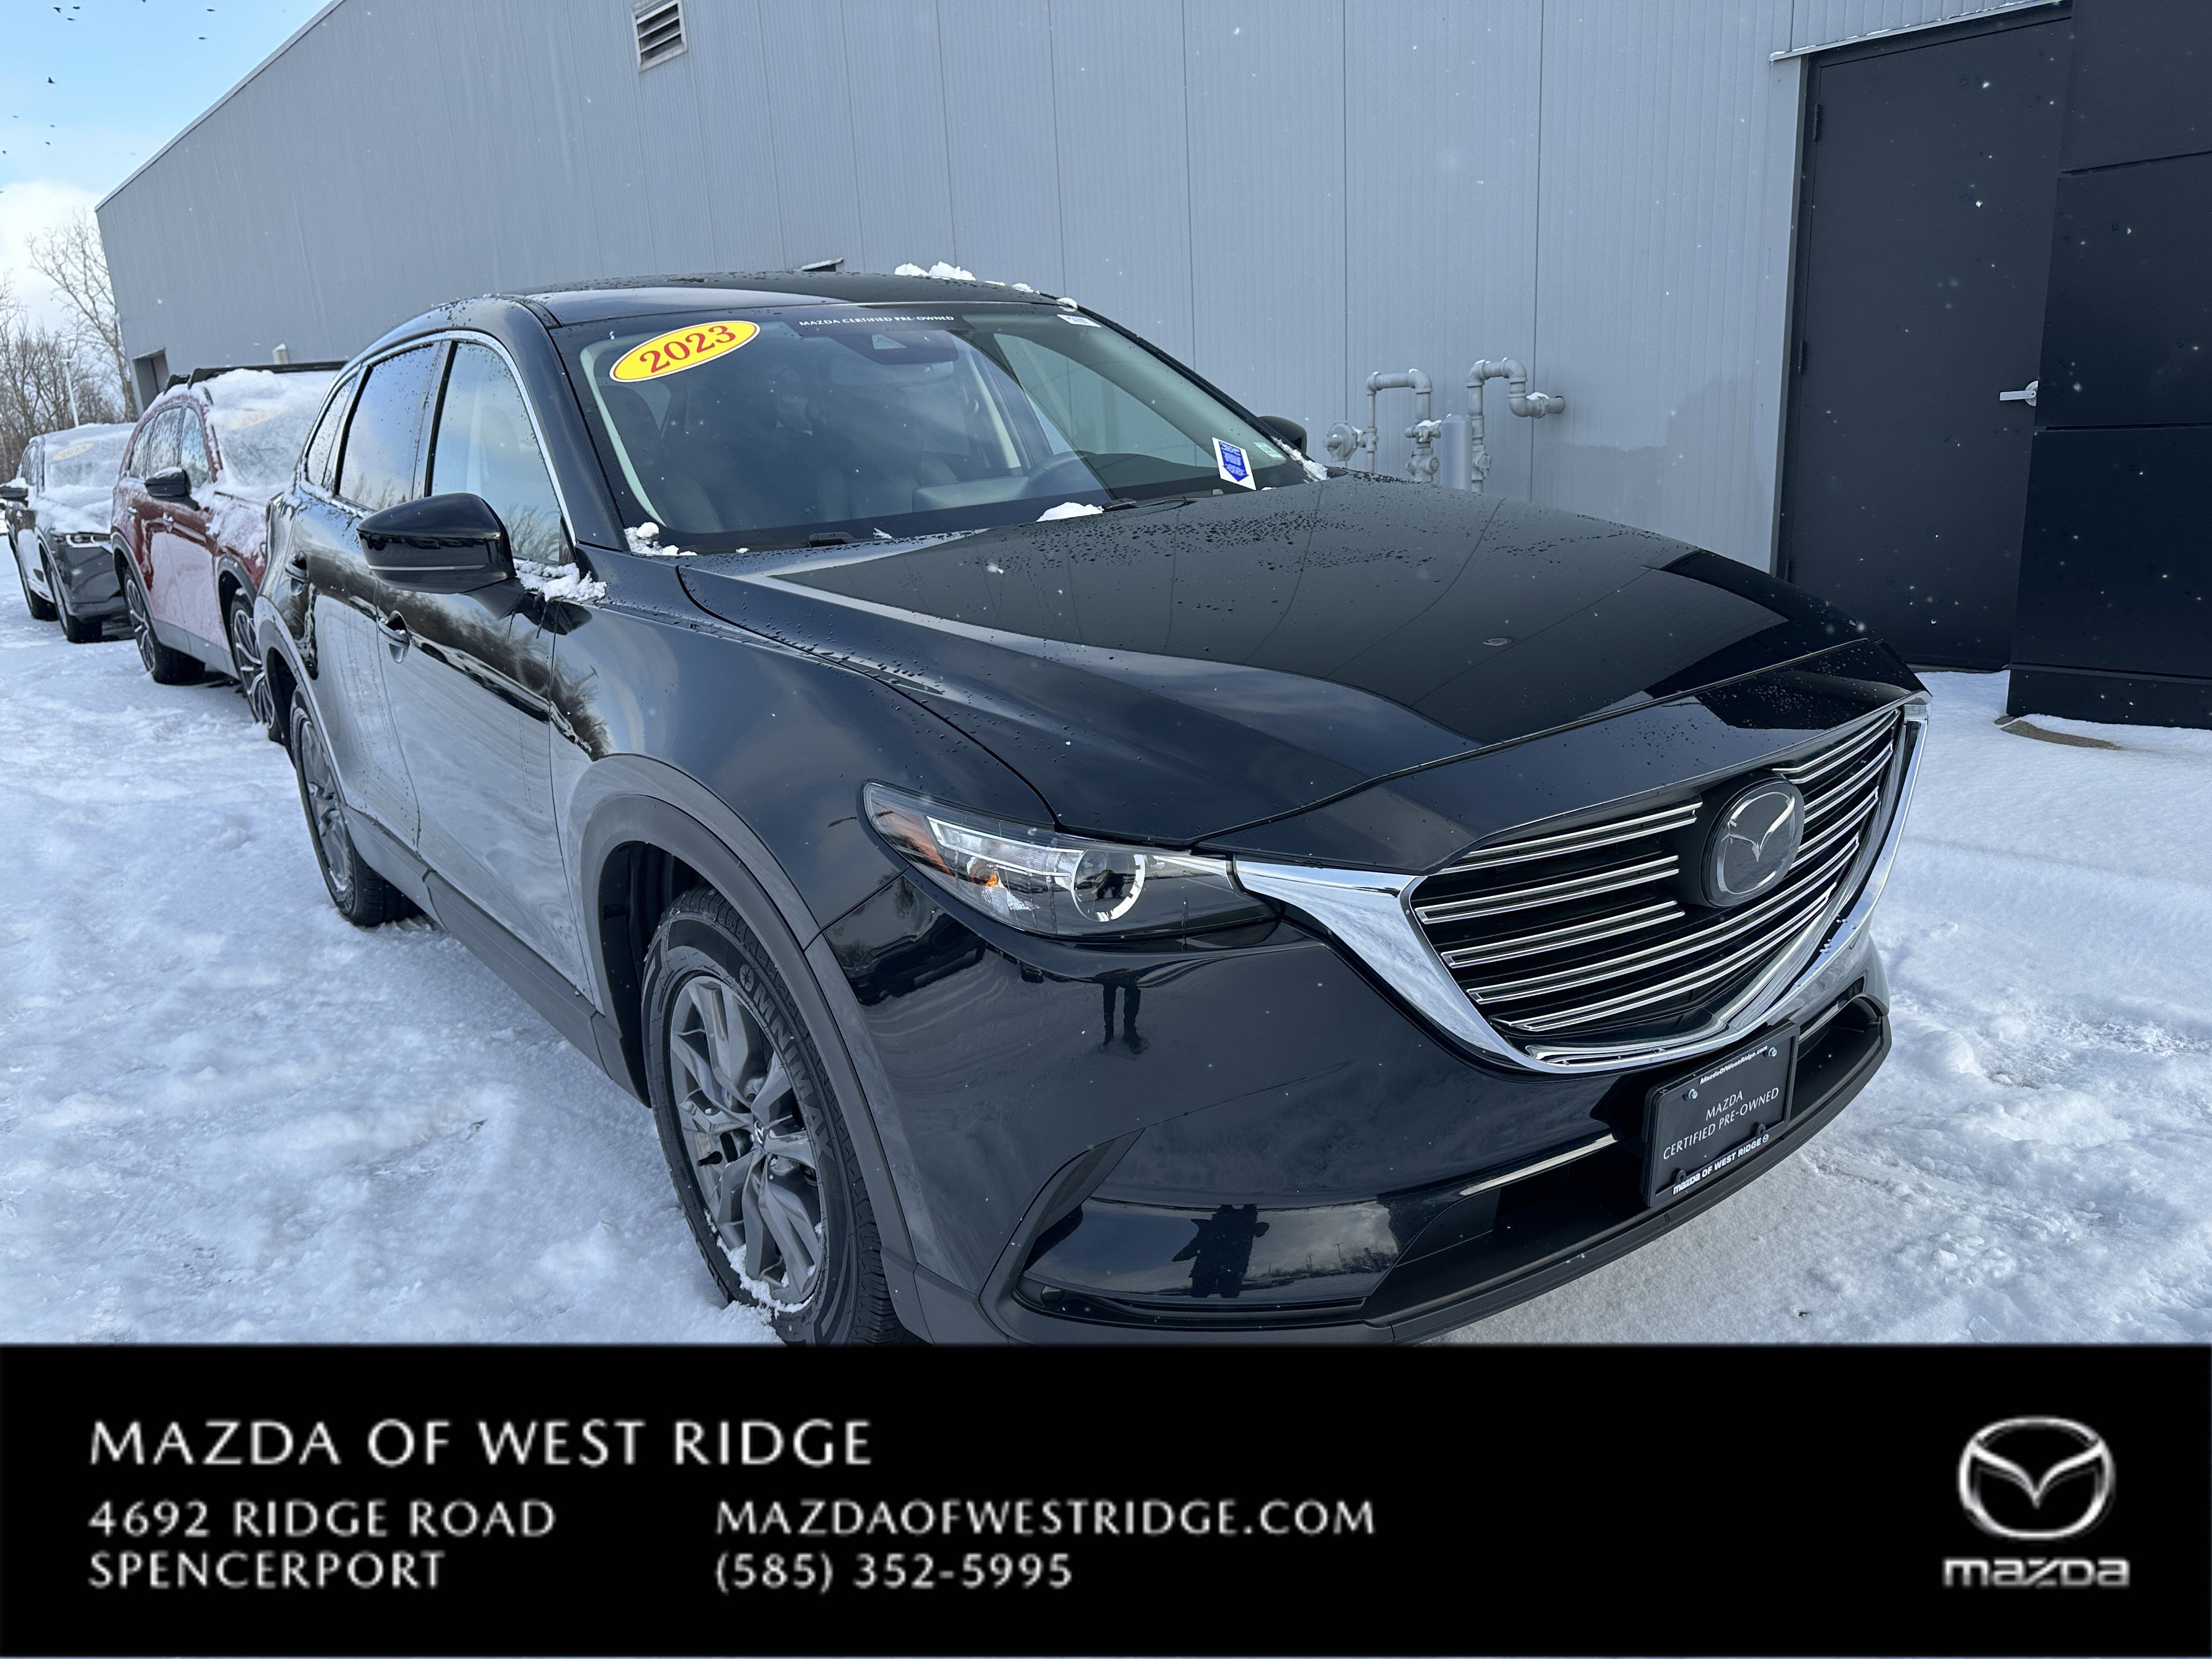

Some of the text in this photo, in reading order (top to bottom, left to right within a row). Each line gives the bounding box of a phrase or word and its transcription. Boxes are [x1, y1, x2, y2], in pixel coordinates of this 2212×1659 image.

[639, 325, 737, 374] 2023
[1663, 1087, 1779, 1160] CERTIFIED PRE-OWNED
[1706, 1091, 1743, 1121] MAZDA
[1702, 1163, 1713, 1178] OF
[1714, 1153, 1736, 1171] WEST
[1737, 1137, 1762, 1158] RIDGE
